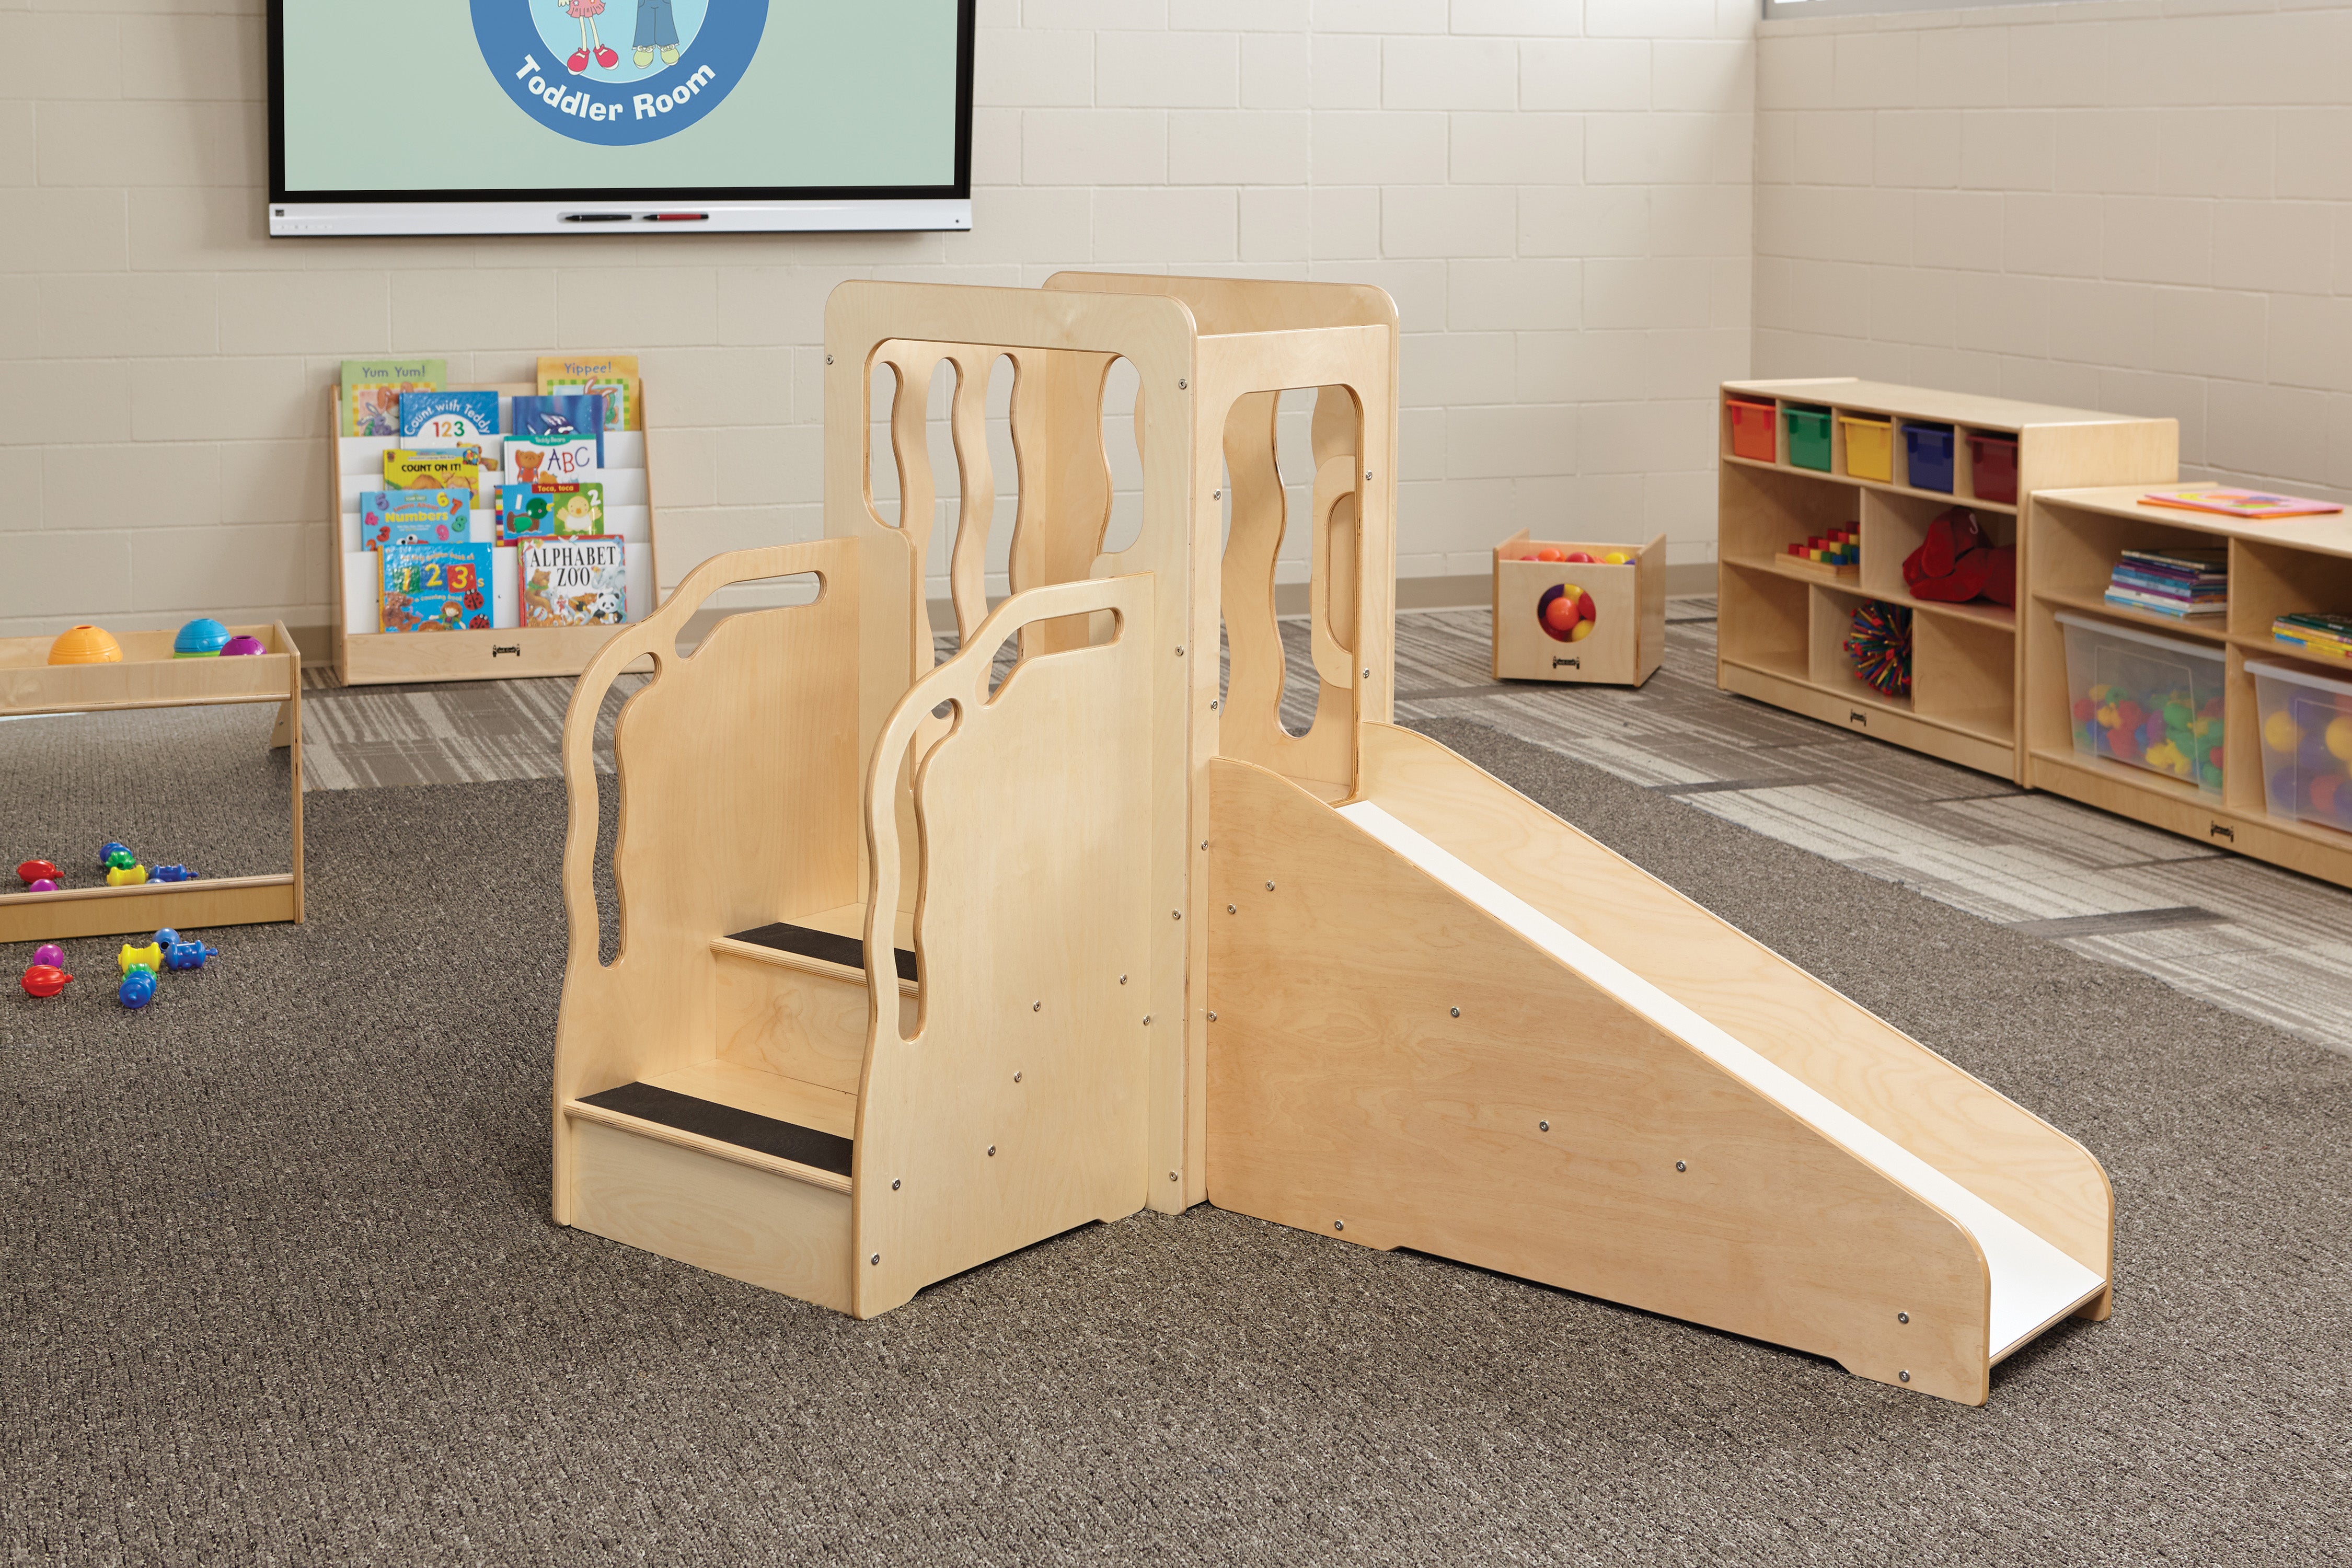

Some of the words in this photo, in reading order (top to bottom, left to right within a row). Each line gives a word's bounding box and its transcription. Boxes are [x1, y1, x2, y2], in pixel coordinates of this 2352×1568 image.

[515, 53, 623, 121] Toddler
[632, 64, 716, 120] Room
[362, 367, 388, 378] Yum
[394, 365, 425, 377] Yum!
[564, 362, 612, 376] Yippee!
[404, 407, 433, 435] Count
[435, 399, 460, 412] with
[464, 403, 491, 434] Teddy
[401, 464, 432, 472] COUNT
[547, 446, 590, 474] ABC
[375, 493, 389, 511] 5
[436, 492, 449, 507] 6
[449, 498, 463, 515] 7
[587, 489, 602, 507] 2
[364, 511, 379, 526] 4
[385, 511, 448, 523] Numbers
[452, 515, 467, 533] 8
[376, 526, 391, 542] 3
[435, 524, 449, 541] 9
[530, 546, 616, 567] ALPHABET
[425, 563, 443, 587] 2
[557, 567, 591, 587] ZOO
